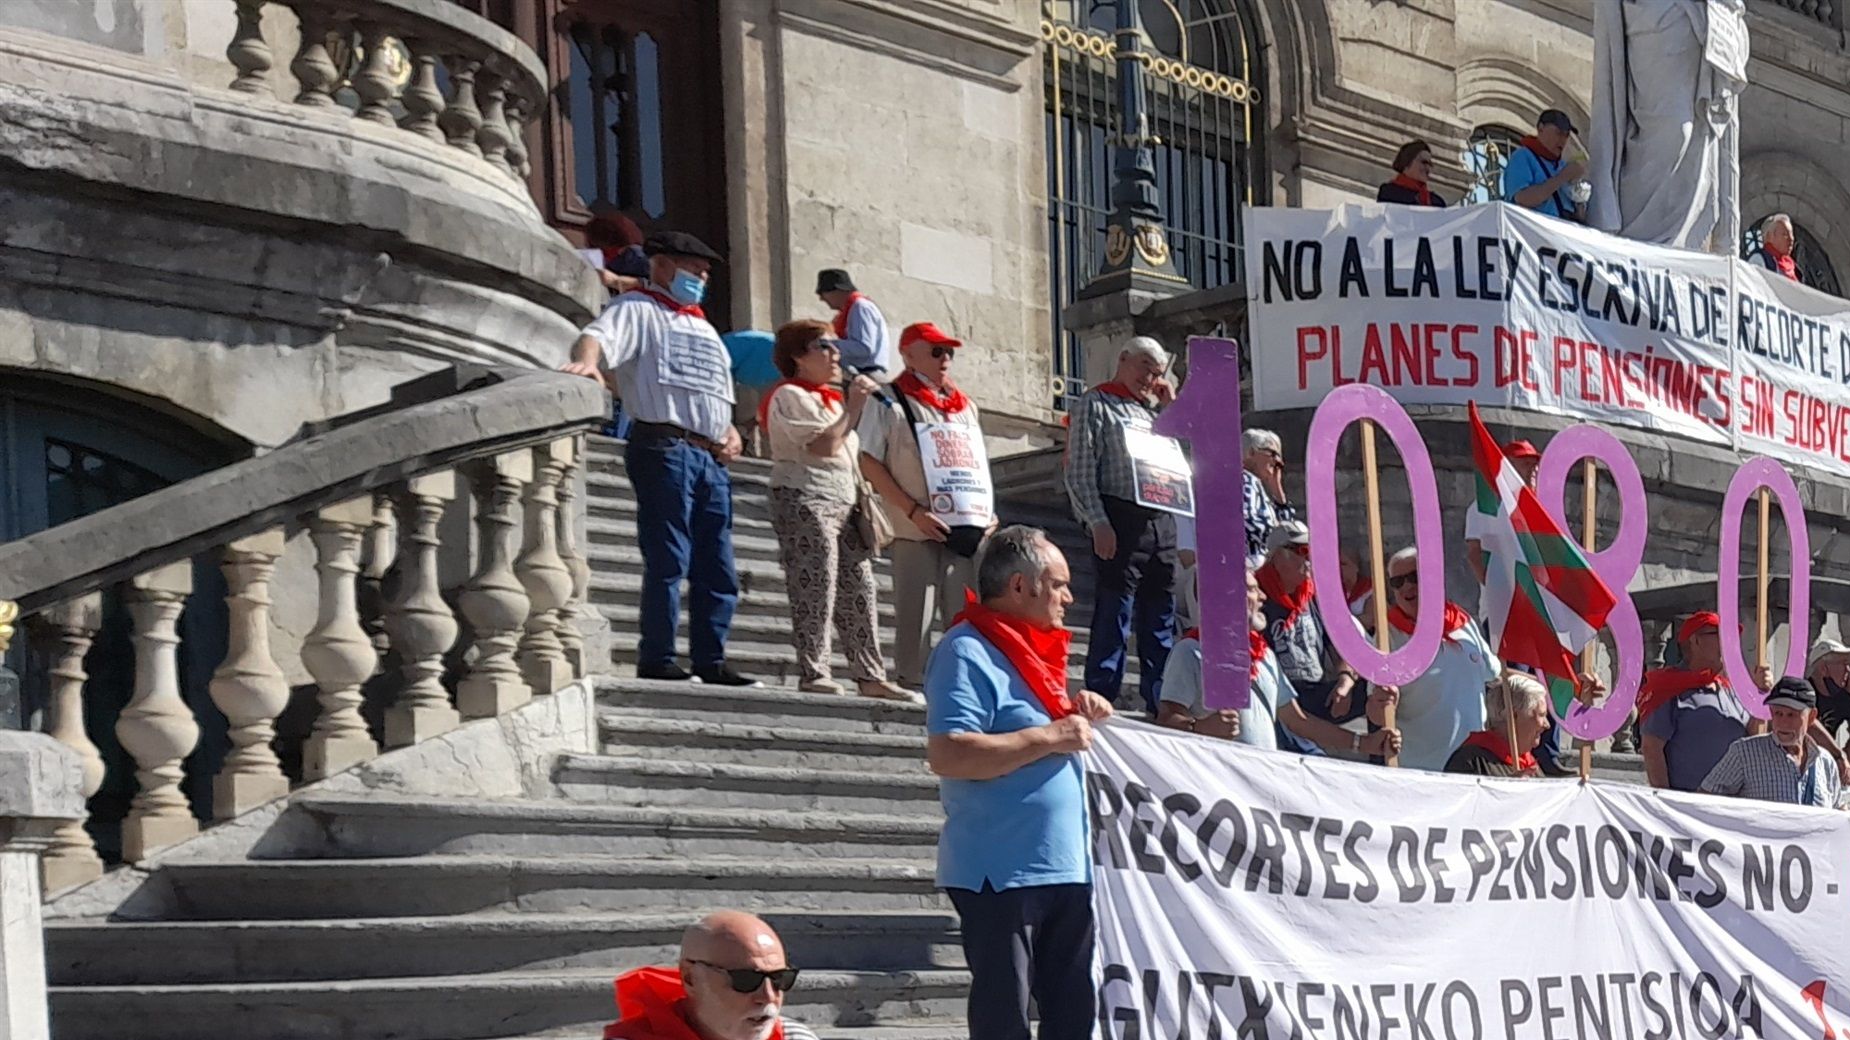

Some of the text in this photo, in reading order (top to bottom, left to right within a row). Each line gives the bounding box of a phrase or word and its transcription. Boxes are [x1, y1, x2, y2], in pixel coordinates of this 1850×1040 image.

[1263, 239, 1323, 304] NO
[1339, 236, 1370, 298] A
[1384, 237, 1440, 299] LA
[1453, 235, 1523, 301] LEY
[1689, 282, 1728, 346] DE
[1737, 292, 1832, 379] RECORTE
[1296, 322, 1479, 390] PLANES
[1494, 325, 1540, 391] DE
[1085, 769, 1380, 904] RECORTES
[1387, 825, 1456, 904] DE
[1461, 823, 1728, 910] PENSIONES
[1742, 843, 1814, 915] NO
